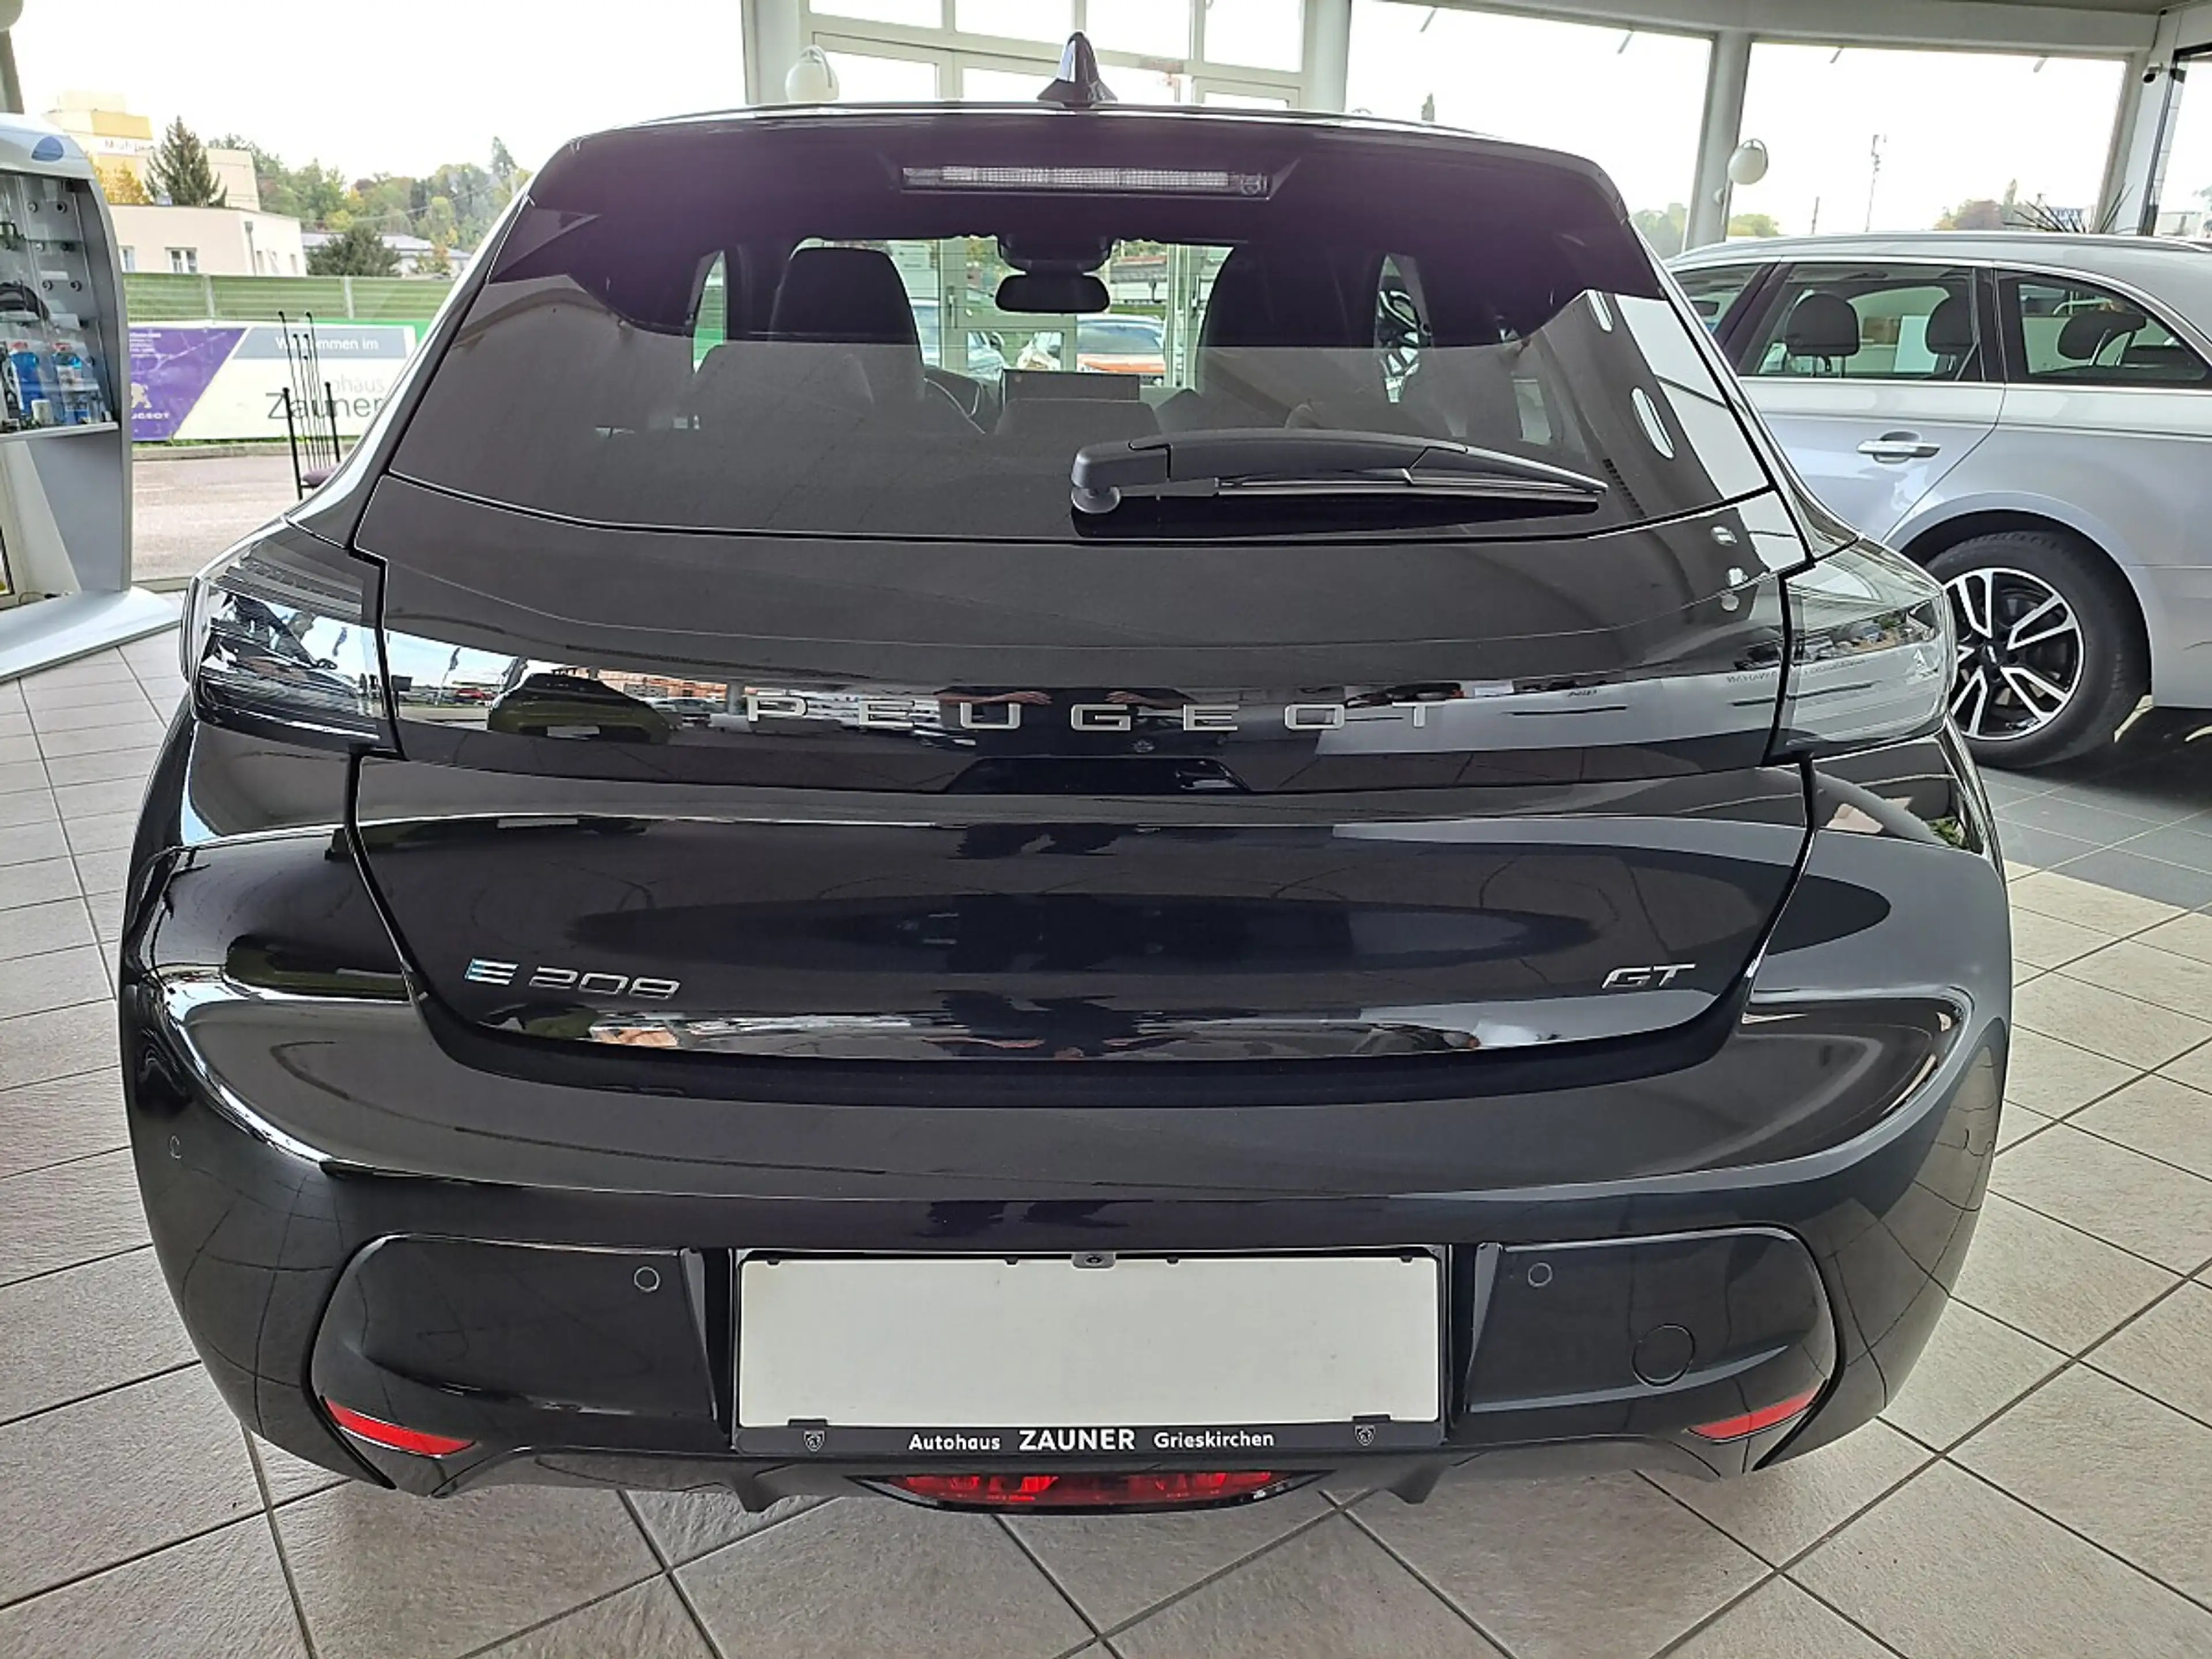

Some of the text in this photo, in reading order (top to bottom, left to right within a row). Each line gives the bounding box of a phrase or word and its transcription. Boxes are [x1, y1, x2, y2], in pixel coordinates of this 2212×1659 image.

[747, 695, 1447, 732] PEUGEOT
[464, 958, 681, 999] E 208
[1601, 963, 1696, 988] GT
[908, 1429, 1275, 1451] Autohaus ZAUNER Grieskirchen
